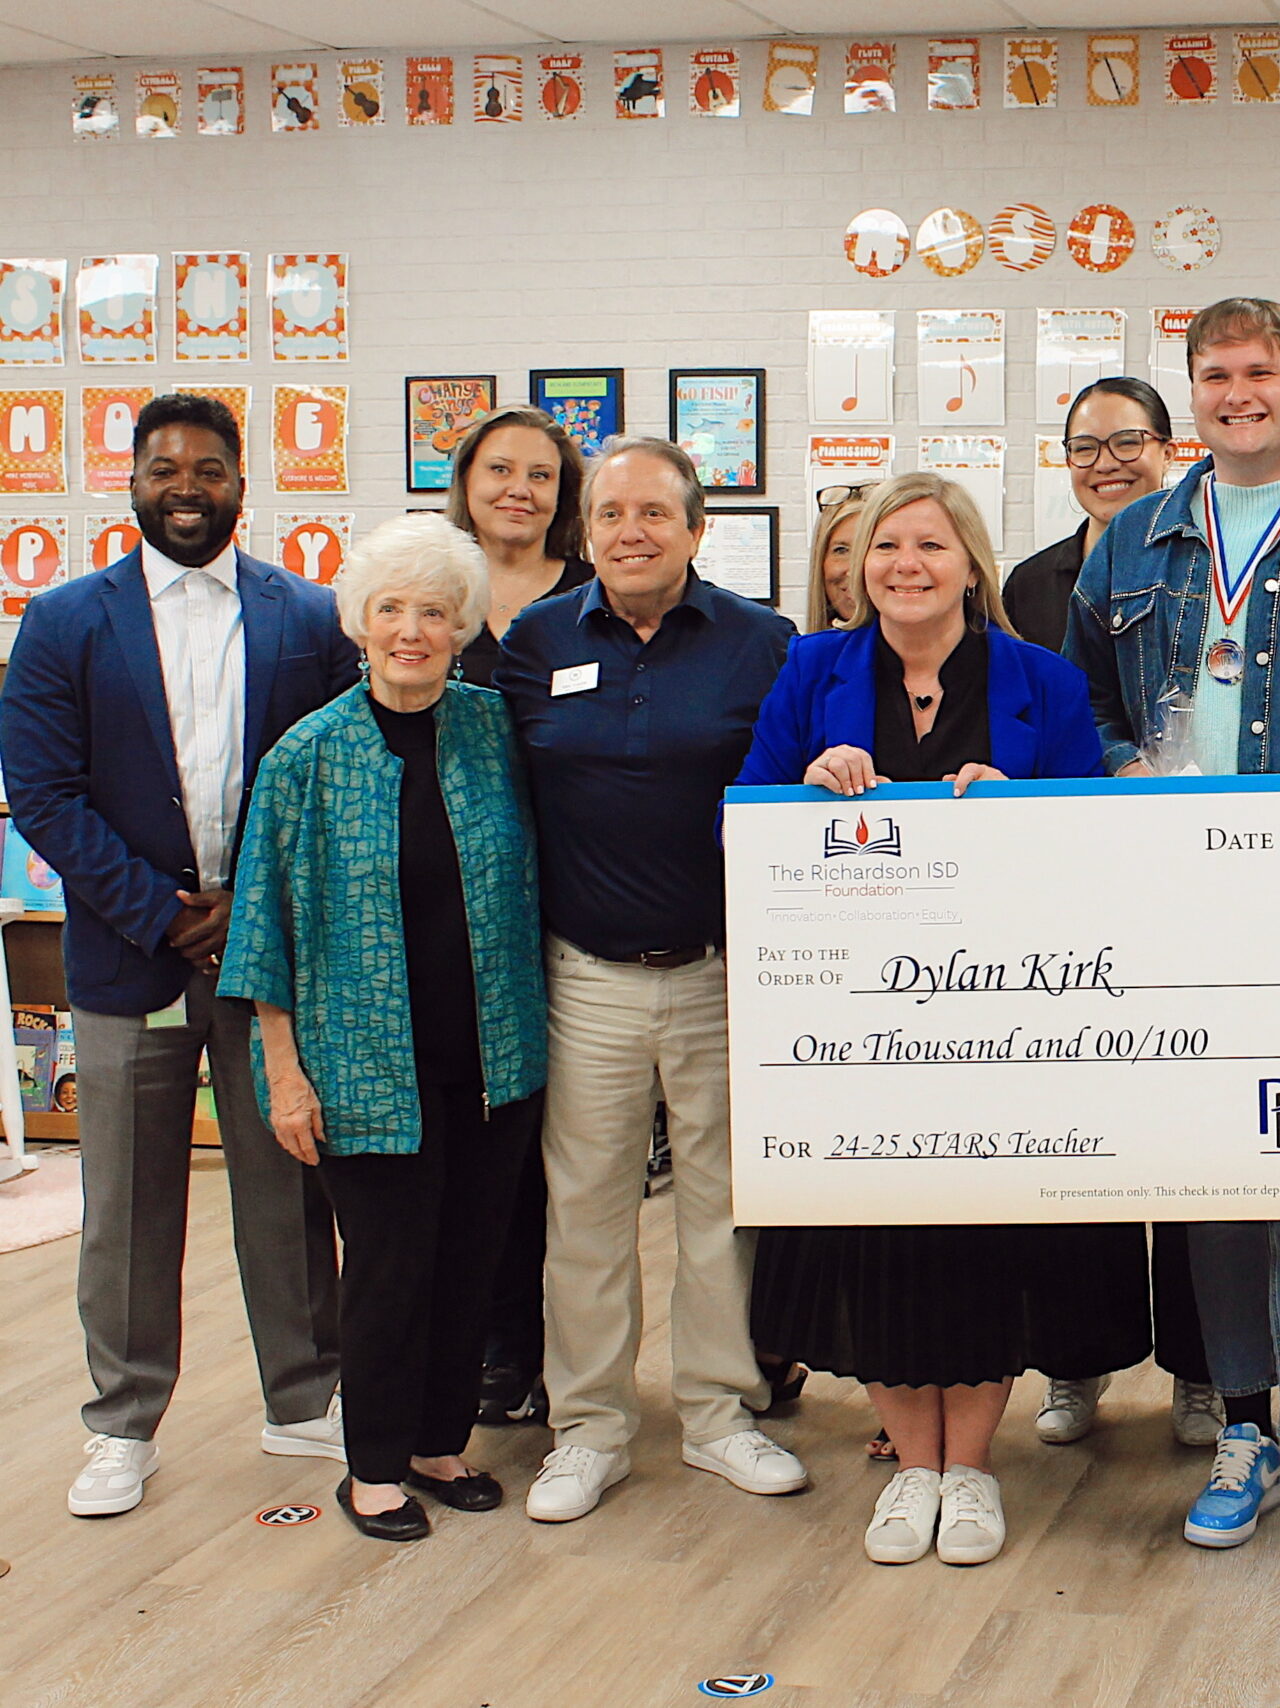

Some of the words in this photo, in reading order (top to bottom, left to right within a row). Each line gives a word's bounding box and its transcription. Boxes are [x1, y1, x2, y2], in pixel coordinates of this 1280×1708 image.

[700, 54, 730, 63] GUITAR
[1164, 318, 1190, 329] HAL
[676, 387, 697, 400] GO
[701, 386, 738, 400] FISH!
[818, 445, 880, 458] PIANISSIMO
[1206, 828, 1275, 851] DATE
[768, 863, 804, 882] The
[811, 861, 920, 881] Richardson
[926, 861, 959, 879] ISD
[824, 883, 905, 897] Foundation
[921, 908, 959, 922] Equity
[758, 946, 787, 962] PAY
[792, 949, 813, 961] TO
[818, 949, 850, 961] THE
[758, 970, 815, 986] ORDER
[820, 969, 844, 985] OF
[880, 949, 1008, 1005] Dylan
[1021, 946, 1125, 998] Kirk
[791, 1033, 853, 1063] One
[862, 1026, 1023, 1062] Thousand
[1025, 1025, 1092, 1060] and
[1094, 1024, 1209, 1065] 00/100
[763, 1135, 813, 1160] FOR
[830, 1133, 901, 1158] 24-25
[906, 1131, 1001, 1159] STARS
[1006, 1128, 1104, 1156] Teacher
[1039, 1187, 1058, 1198] For
[1060, 1187, 1124, 1200] presentation
[1126, 1187, 1151, 1200] only.
[1153, 1186, 1177, 1197] This
[1178, 1185, 1209, 1197] check
[1211, 1185, 1220, 1197] is
[1222, 1186, 1240, 1197] not
[1242, 1184, 1259, 1197] for
